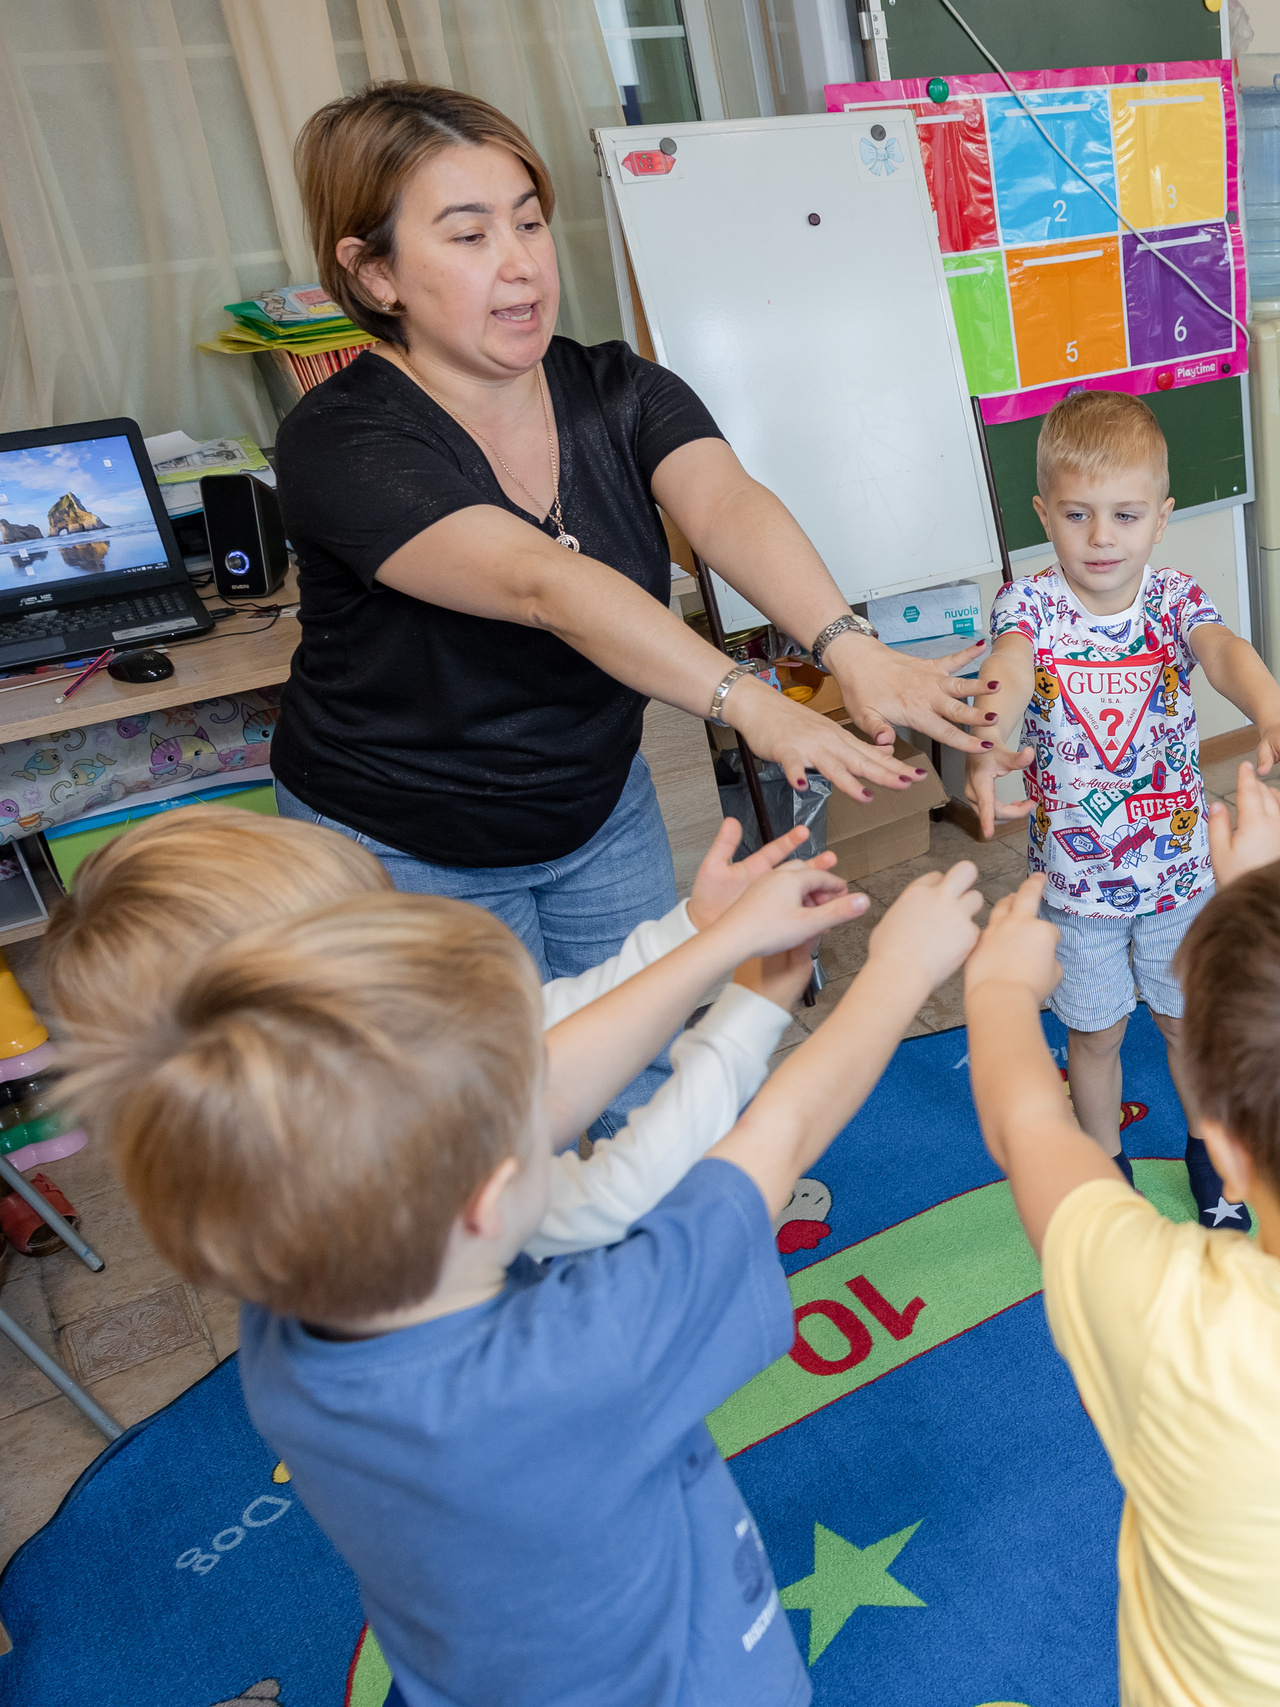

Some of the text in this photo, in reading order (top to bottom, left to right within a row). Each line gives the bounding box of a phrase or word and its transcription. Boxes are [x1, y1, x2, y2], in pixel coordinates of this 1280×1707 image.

[1166, 185, 1177, 209] 3
[1053, 200, 1068, 223] 2
[1173, 315, 1188, 342] 6
[1066, 341, 1079, 363] 5
[1177, 363, 1216, 378] Playtime
[18, 593, 53, 606] ASUS
[945, 605, 978, 619] nuvola
[1058, 633, 1078, 646] Los
[1067, 671, 1152, 695] GUESS
[1081, 705, 1100, 730] WASHED
[1099, 708, 1124, 737] ?
[1125, 707, 1138, 726] JEANS
[1068, 777, 1086, 790] Los
[1085, 778, 1132, 792] Angeles
[1130, 795, 1187, 821] GUESS
[788, 1274, 927, 1376] 10
[175, 1494, 292, 1577] Dog
